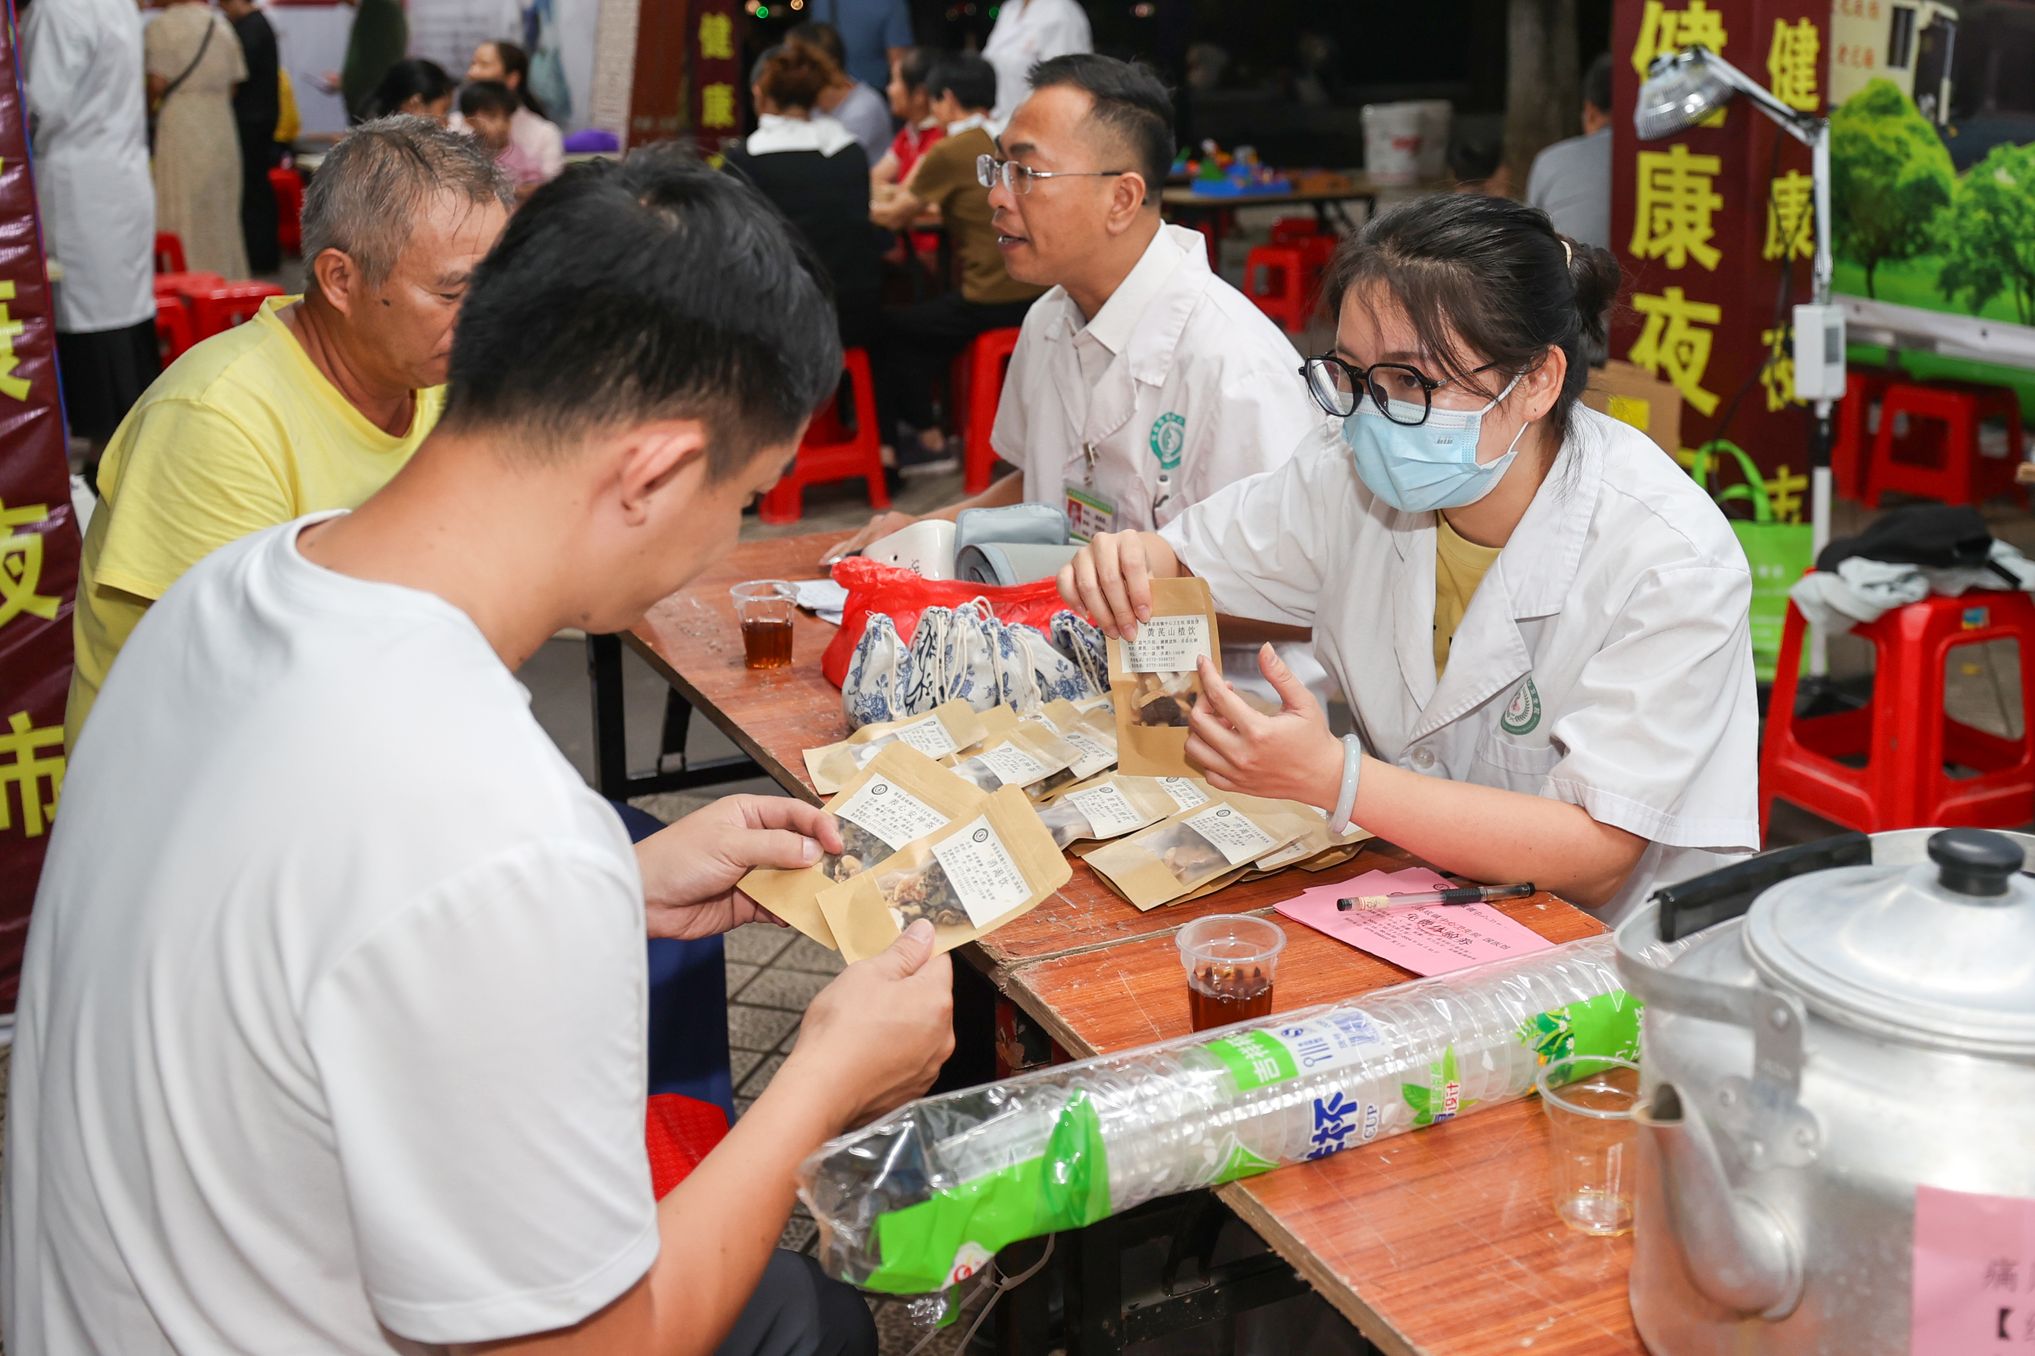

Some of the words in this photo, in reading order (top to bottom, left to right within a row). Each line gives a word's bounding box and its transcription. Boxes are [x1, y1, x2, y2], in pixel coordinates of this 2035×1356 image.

[1628, 0, 1728, 472] 健康夜
[1363, 1104, 1379, 1140] CUP
